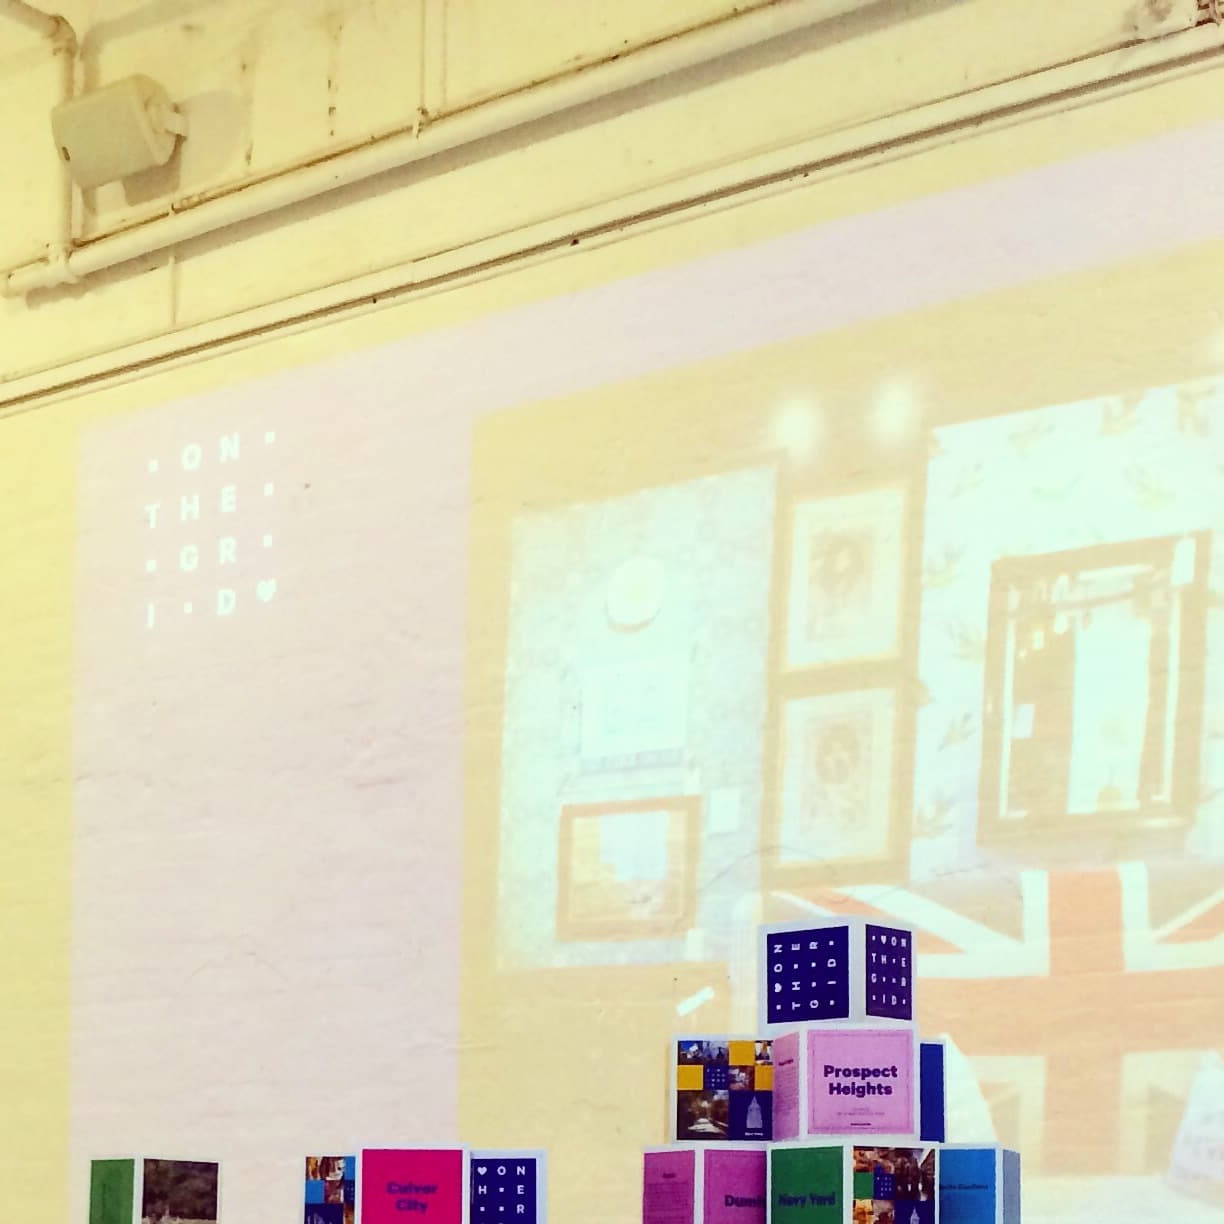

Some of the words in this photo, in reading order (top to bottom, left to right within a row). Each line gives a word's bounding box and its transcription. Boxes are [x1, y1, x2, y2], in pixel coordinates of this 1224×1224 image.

[144, 484, 237, 529] THE
[823, 1064, 898, 1080] Prospect
[828, 1081, 893, 1098] Heights
[386, 1181, 438, 1195] Culver
[396, 1198, 428, 1214] City
[809, 1192, 836, 1206] Yard
